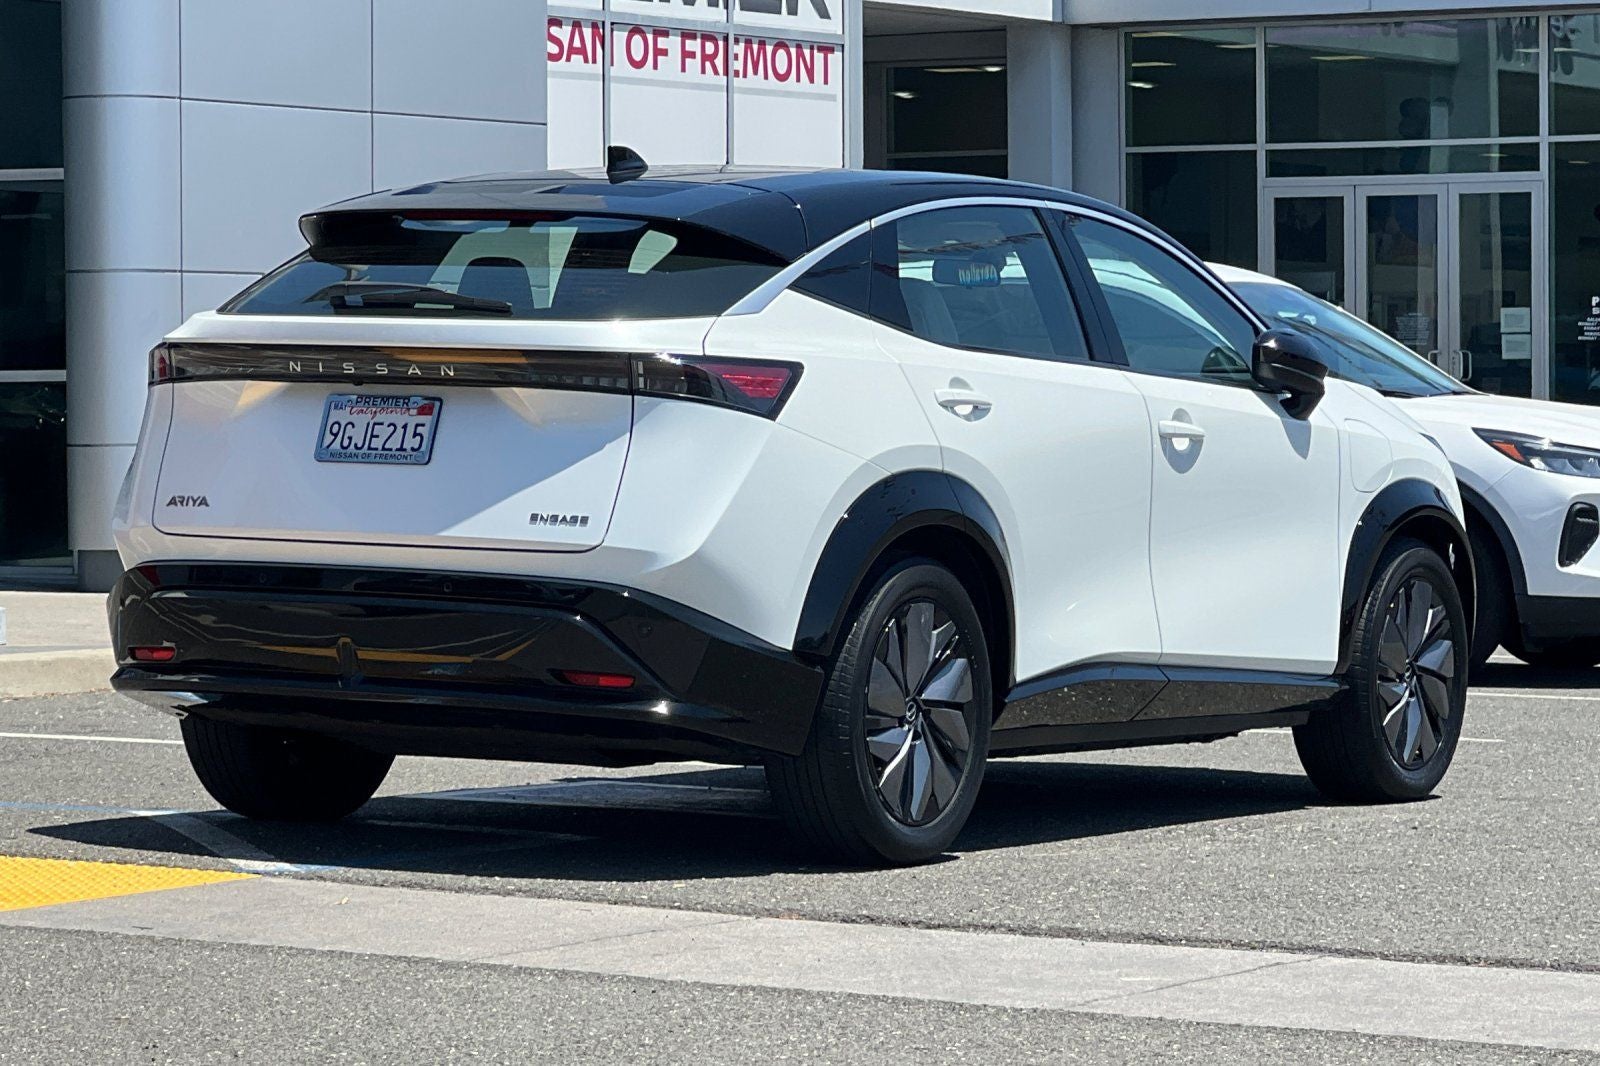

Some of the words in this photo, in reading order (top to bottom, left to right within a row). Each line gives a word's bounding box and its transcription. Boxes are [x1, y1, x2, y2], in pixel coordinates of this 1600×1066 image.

[626, 26, 670, 70] OF
[680, 31, 835, 85] FREMONT
[289, 361, 454, 376] NISSAN
[355, 396, 410, 407] PREMIER
[349, 406, 410, 420] California
[326, 421, 426, 452] 9GJE215
[329, 452, 361, 460] NISSAN
[373, 453, 414, 461] FREMONT
[166, 495, 210, 507] ARIYA
[528, 513, 590, 527] ENGAGE
